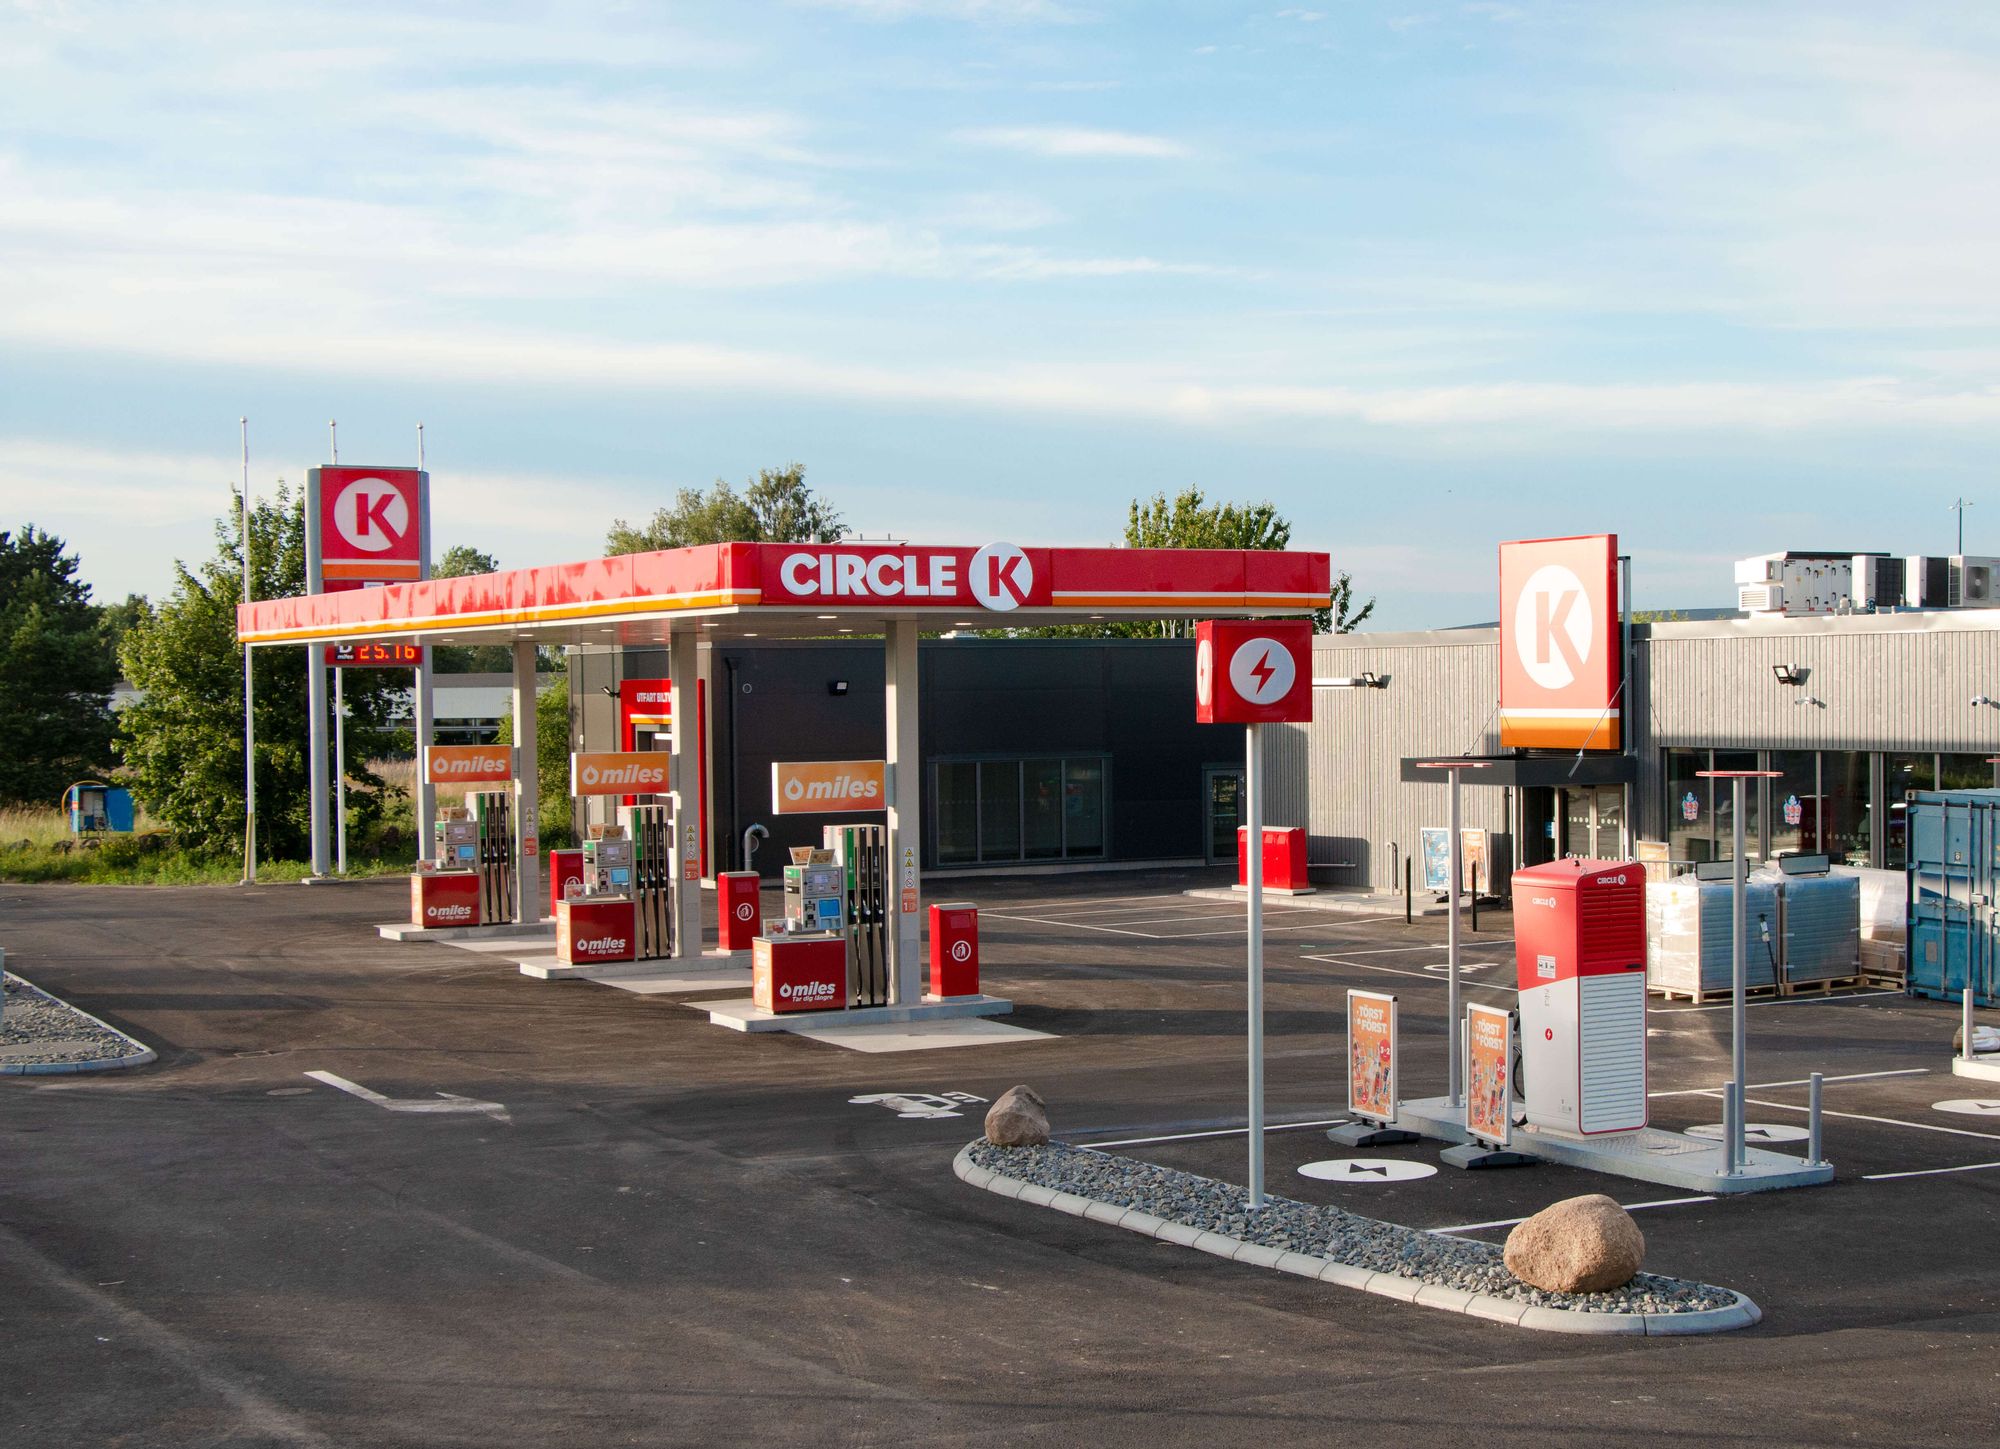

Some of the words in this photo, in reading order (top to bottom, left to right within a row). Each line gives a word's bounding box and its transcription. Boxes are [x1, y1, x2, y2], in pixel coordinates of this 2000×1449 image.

[780, 552, 957, 597] CIRCLE
[450, 755, 507, 774] miles
[601, 764, 665, 785] miles
[806, 775, 878, 799] miles
[1597, 876, 1617, 885] CIRCLE
[1532, 897, 1548, 906] CIRCLE
[437, 904, 472, 916] miles
[588, 936, 626, 949] miles
[792, 981, 836, 996] miles
[1359, 1004, 1384, 1021] TÖRST
